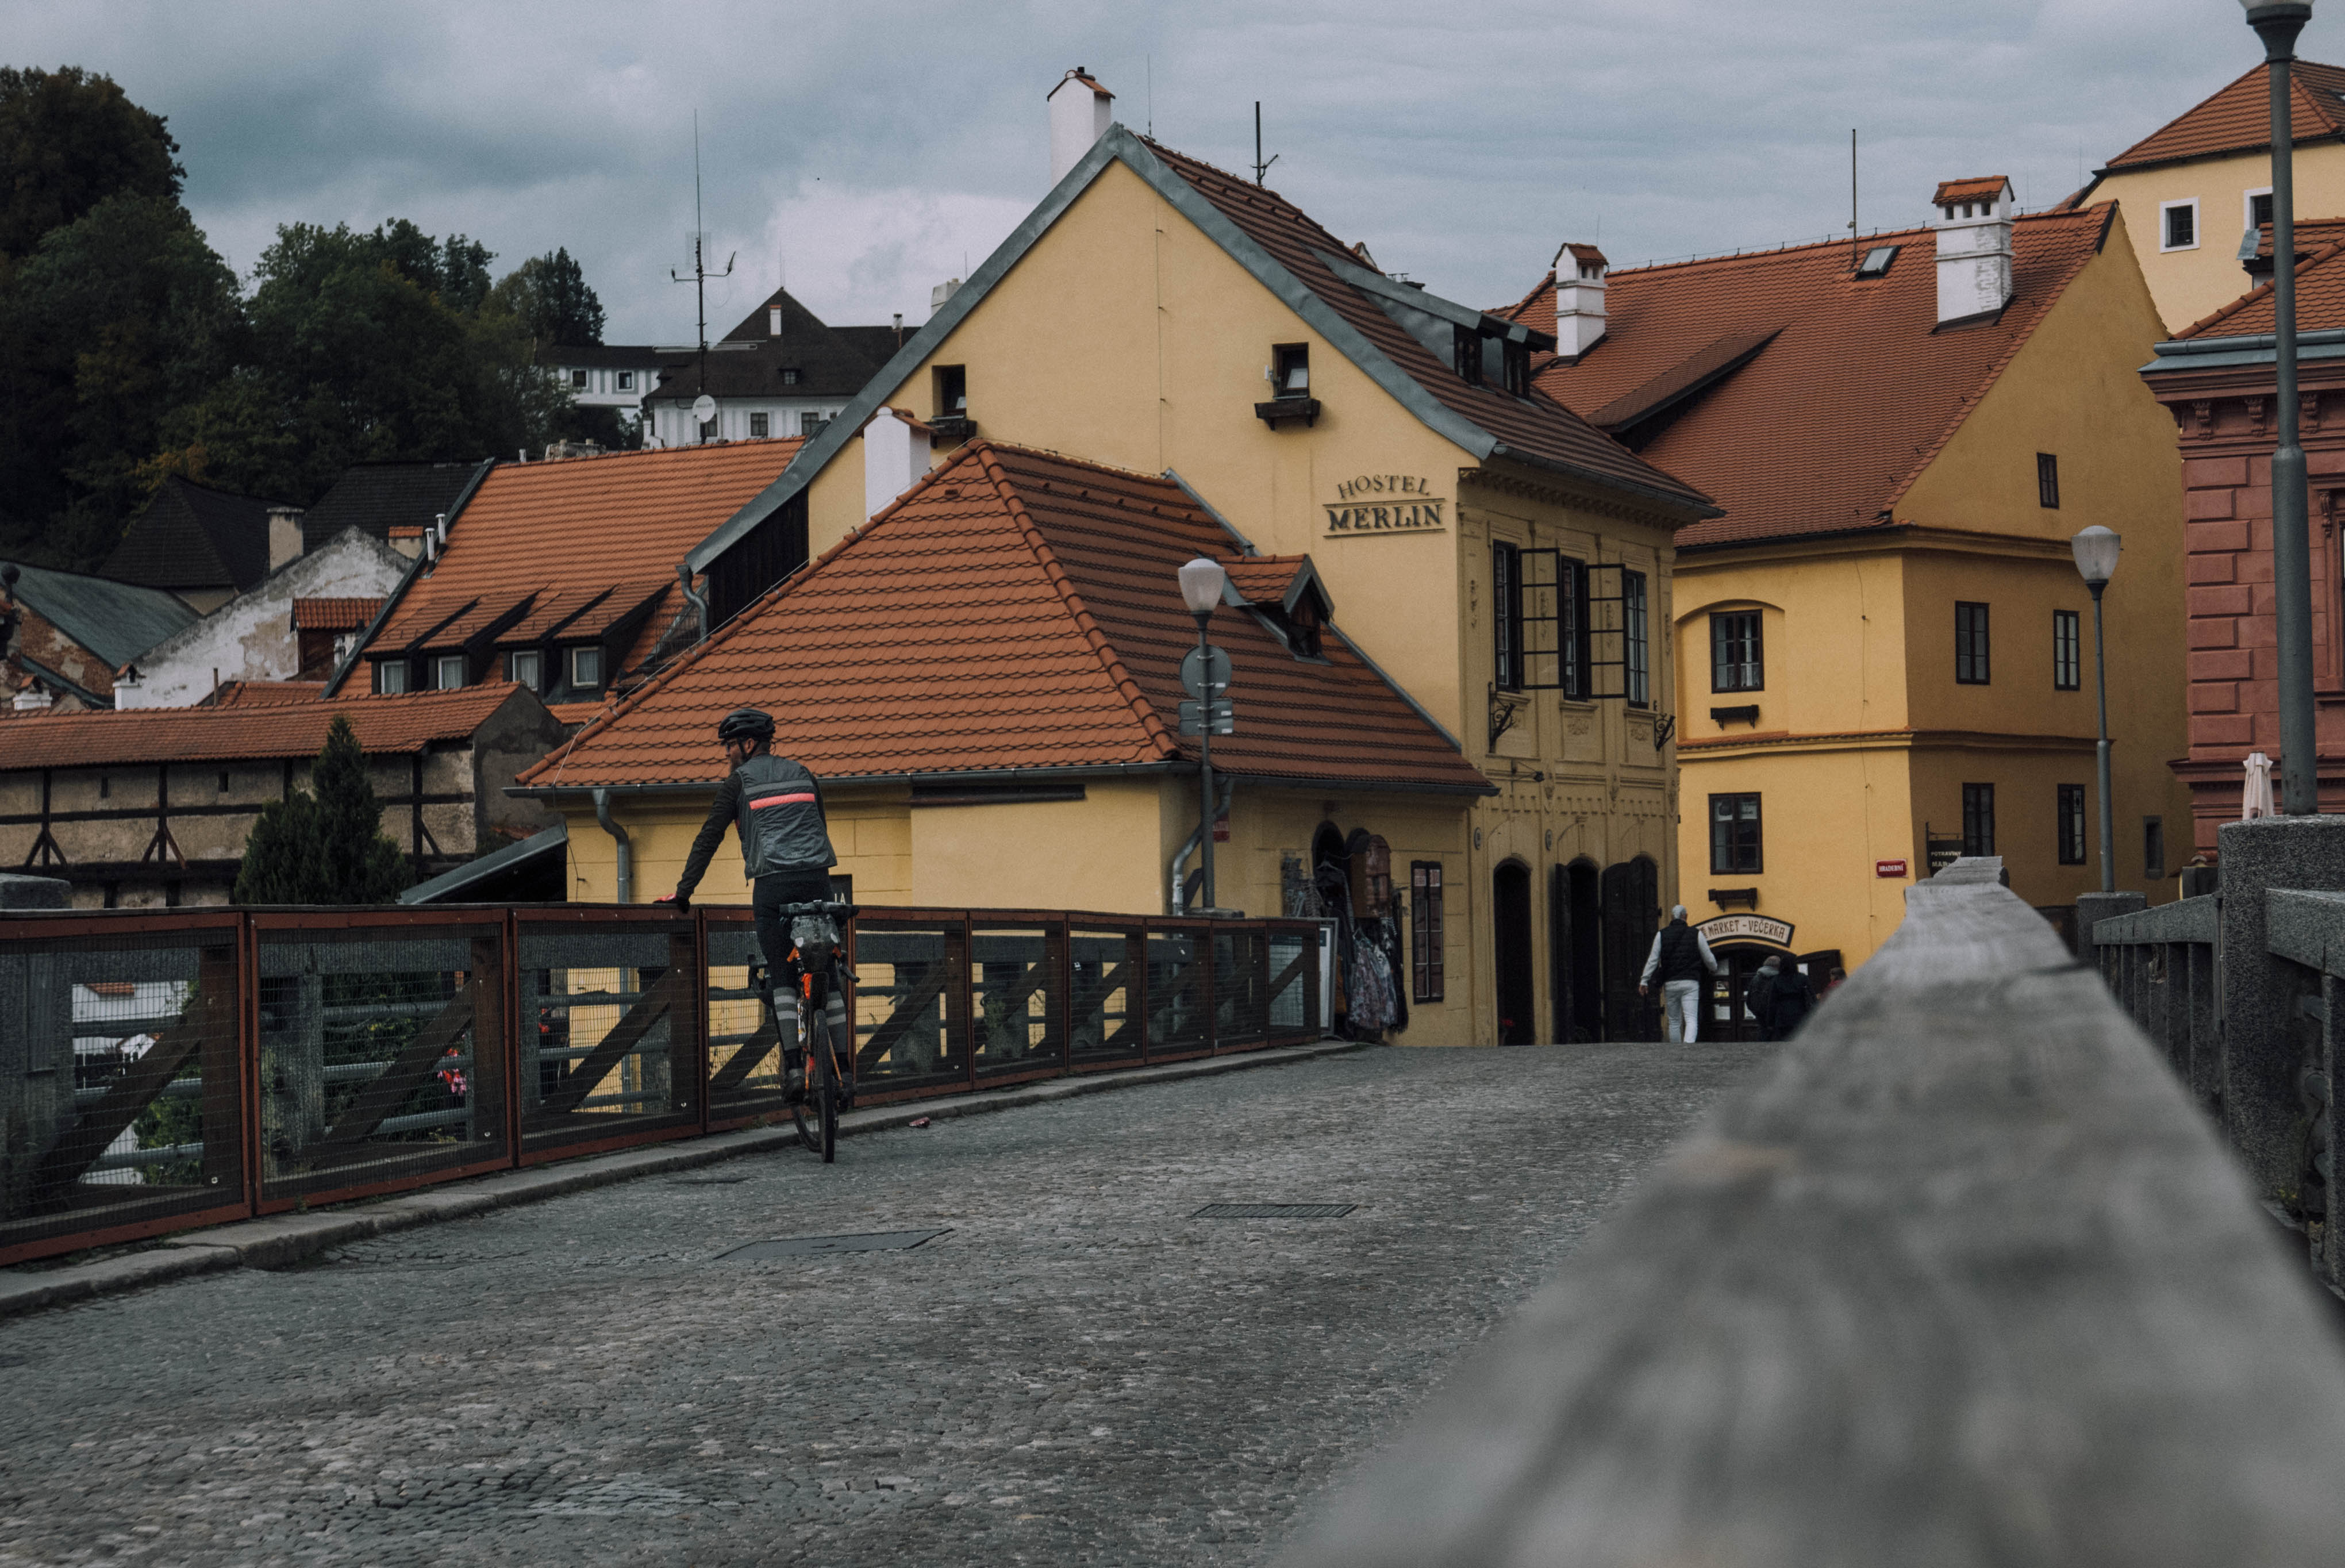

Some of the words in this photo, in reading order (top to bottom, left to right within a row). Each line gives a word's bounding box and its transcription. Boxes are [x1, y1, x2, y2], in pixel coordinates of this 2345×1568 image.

[1337, 474, 1430, 499] HOSTEL
[1327, 504, 1442, 531] MERLIN
[1708, 920, 1740, 938] MARKET
[1748, 920, 1785, 939] VEČERKA
